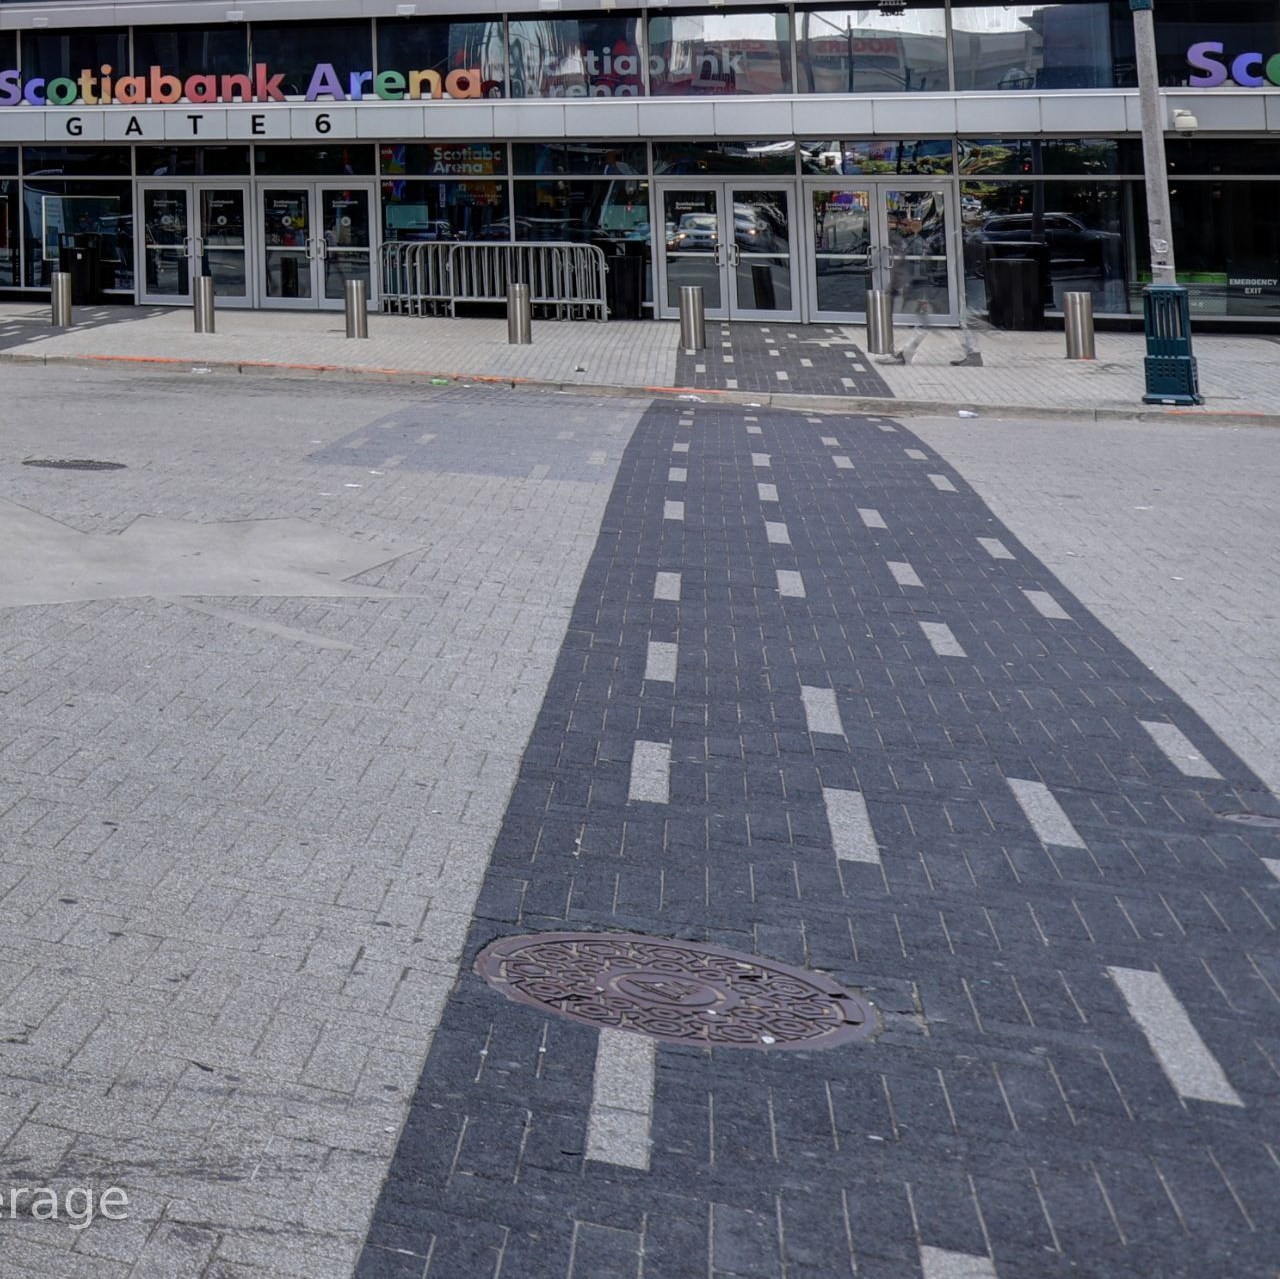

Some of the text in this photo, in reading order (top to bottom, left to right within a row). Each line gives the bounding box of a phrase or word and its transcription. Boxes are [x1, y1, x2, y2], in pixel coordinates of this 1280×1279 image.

[304, 63, 482, 102] Arena
[65, 113, 331, 136] GATE 6
[433, 162, 483, 173] Arena
[1229, 278, 1278, 286] EMERGENCY
